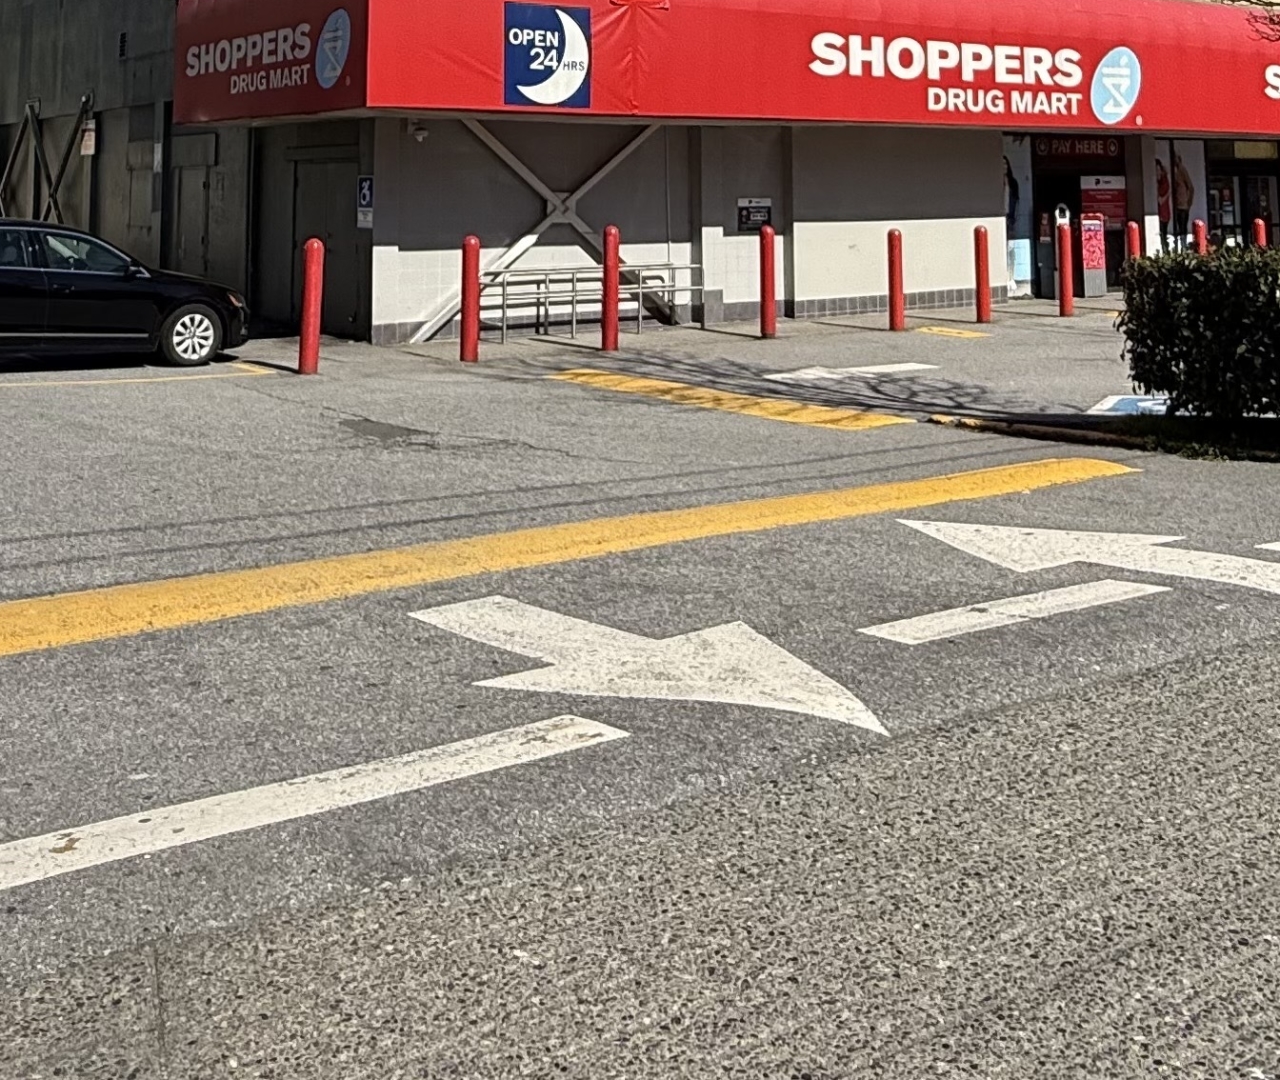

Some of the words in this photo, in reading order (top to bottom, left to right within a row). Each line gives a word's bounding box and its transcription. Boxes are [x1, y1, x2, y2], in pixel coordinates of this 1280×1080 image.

[186, 23, 311, 77] SHOPPERS
[509, 28, 558, 47] OPEN
[529, 47, 558, 70] 24
[563, 61, 585, 72] HRS
[808, 32, 1083, 87] SHOPPERS
[230, 71, 267, 94] DRUG
[270, 64, 310, 89] MART
[928, 87, 1005, 113] DRUG
[1011, 90, 1082, 116] MART
[1052, 140, 1071, 153] PAY
[1075, 140, 1104, 154] HERE
